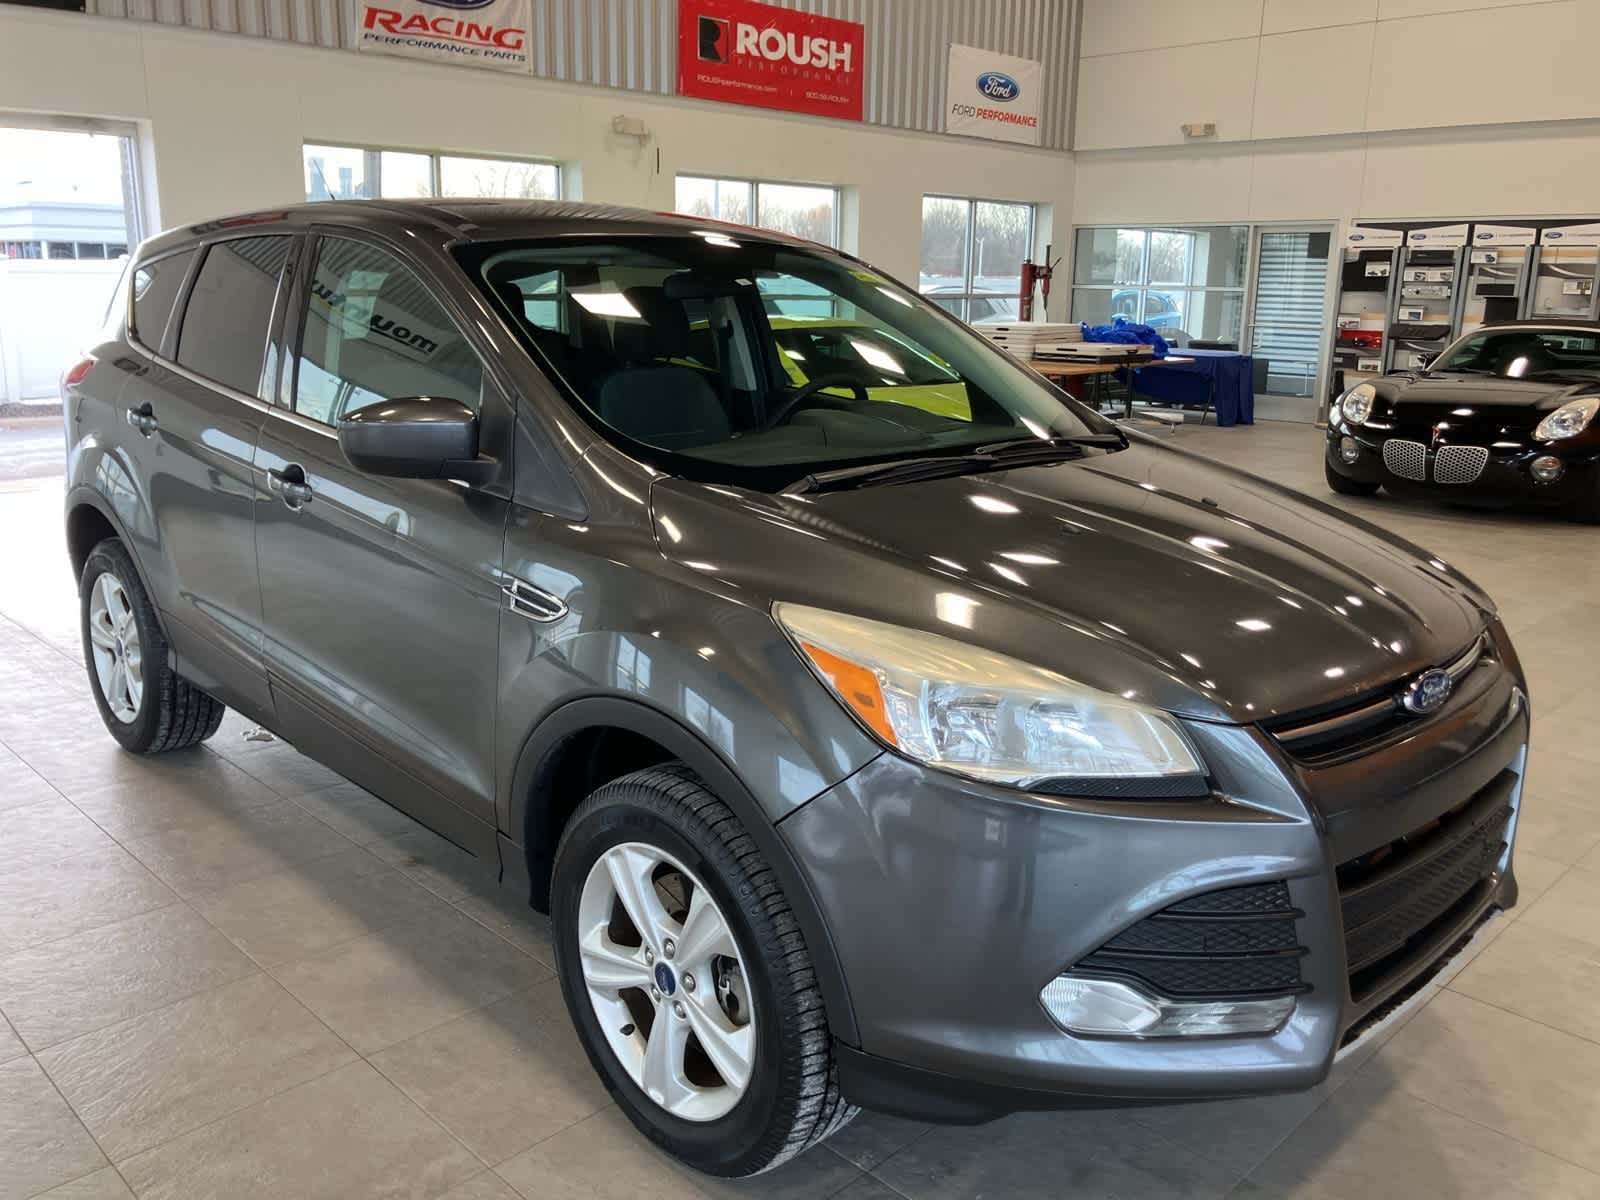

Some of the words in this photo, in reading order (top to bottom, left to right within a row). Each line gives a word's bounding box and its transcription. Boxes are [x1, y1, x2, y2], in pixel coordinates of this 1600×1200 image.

[363, 6, 526, 50] RACING
[363, 32, 480, 56] PERFORMANCE
[483, 50, 527, 62] PARTS
[736, 22, 852, 72] ROUSH
[984, 76, 1012, 98] Ford
[951, 103, 976, 117] FORD
[976, 107, 1037, 128] PERFORMANCE
